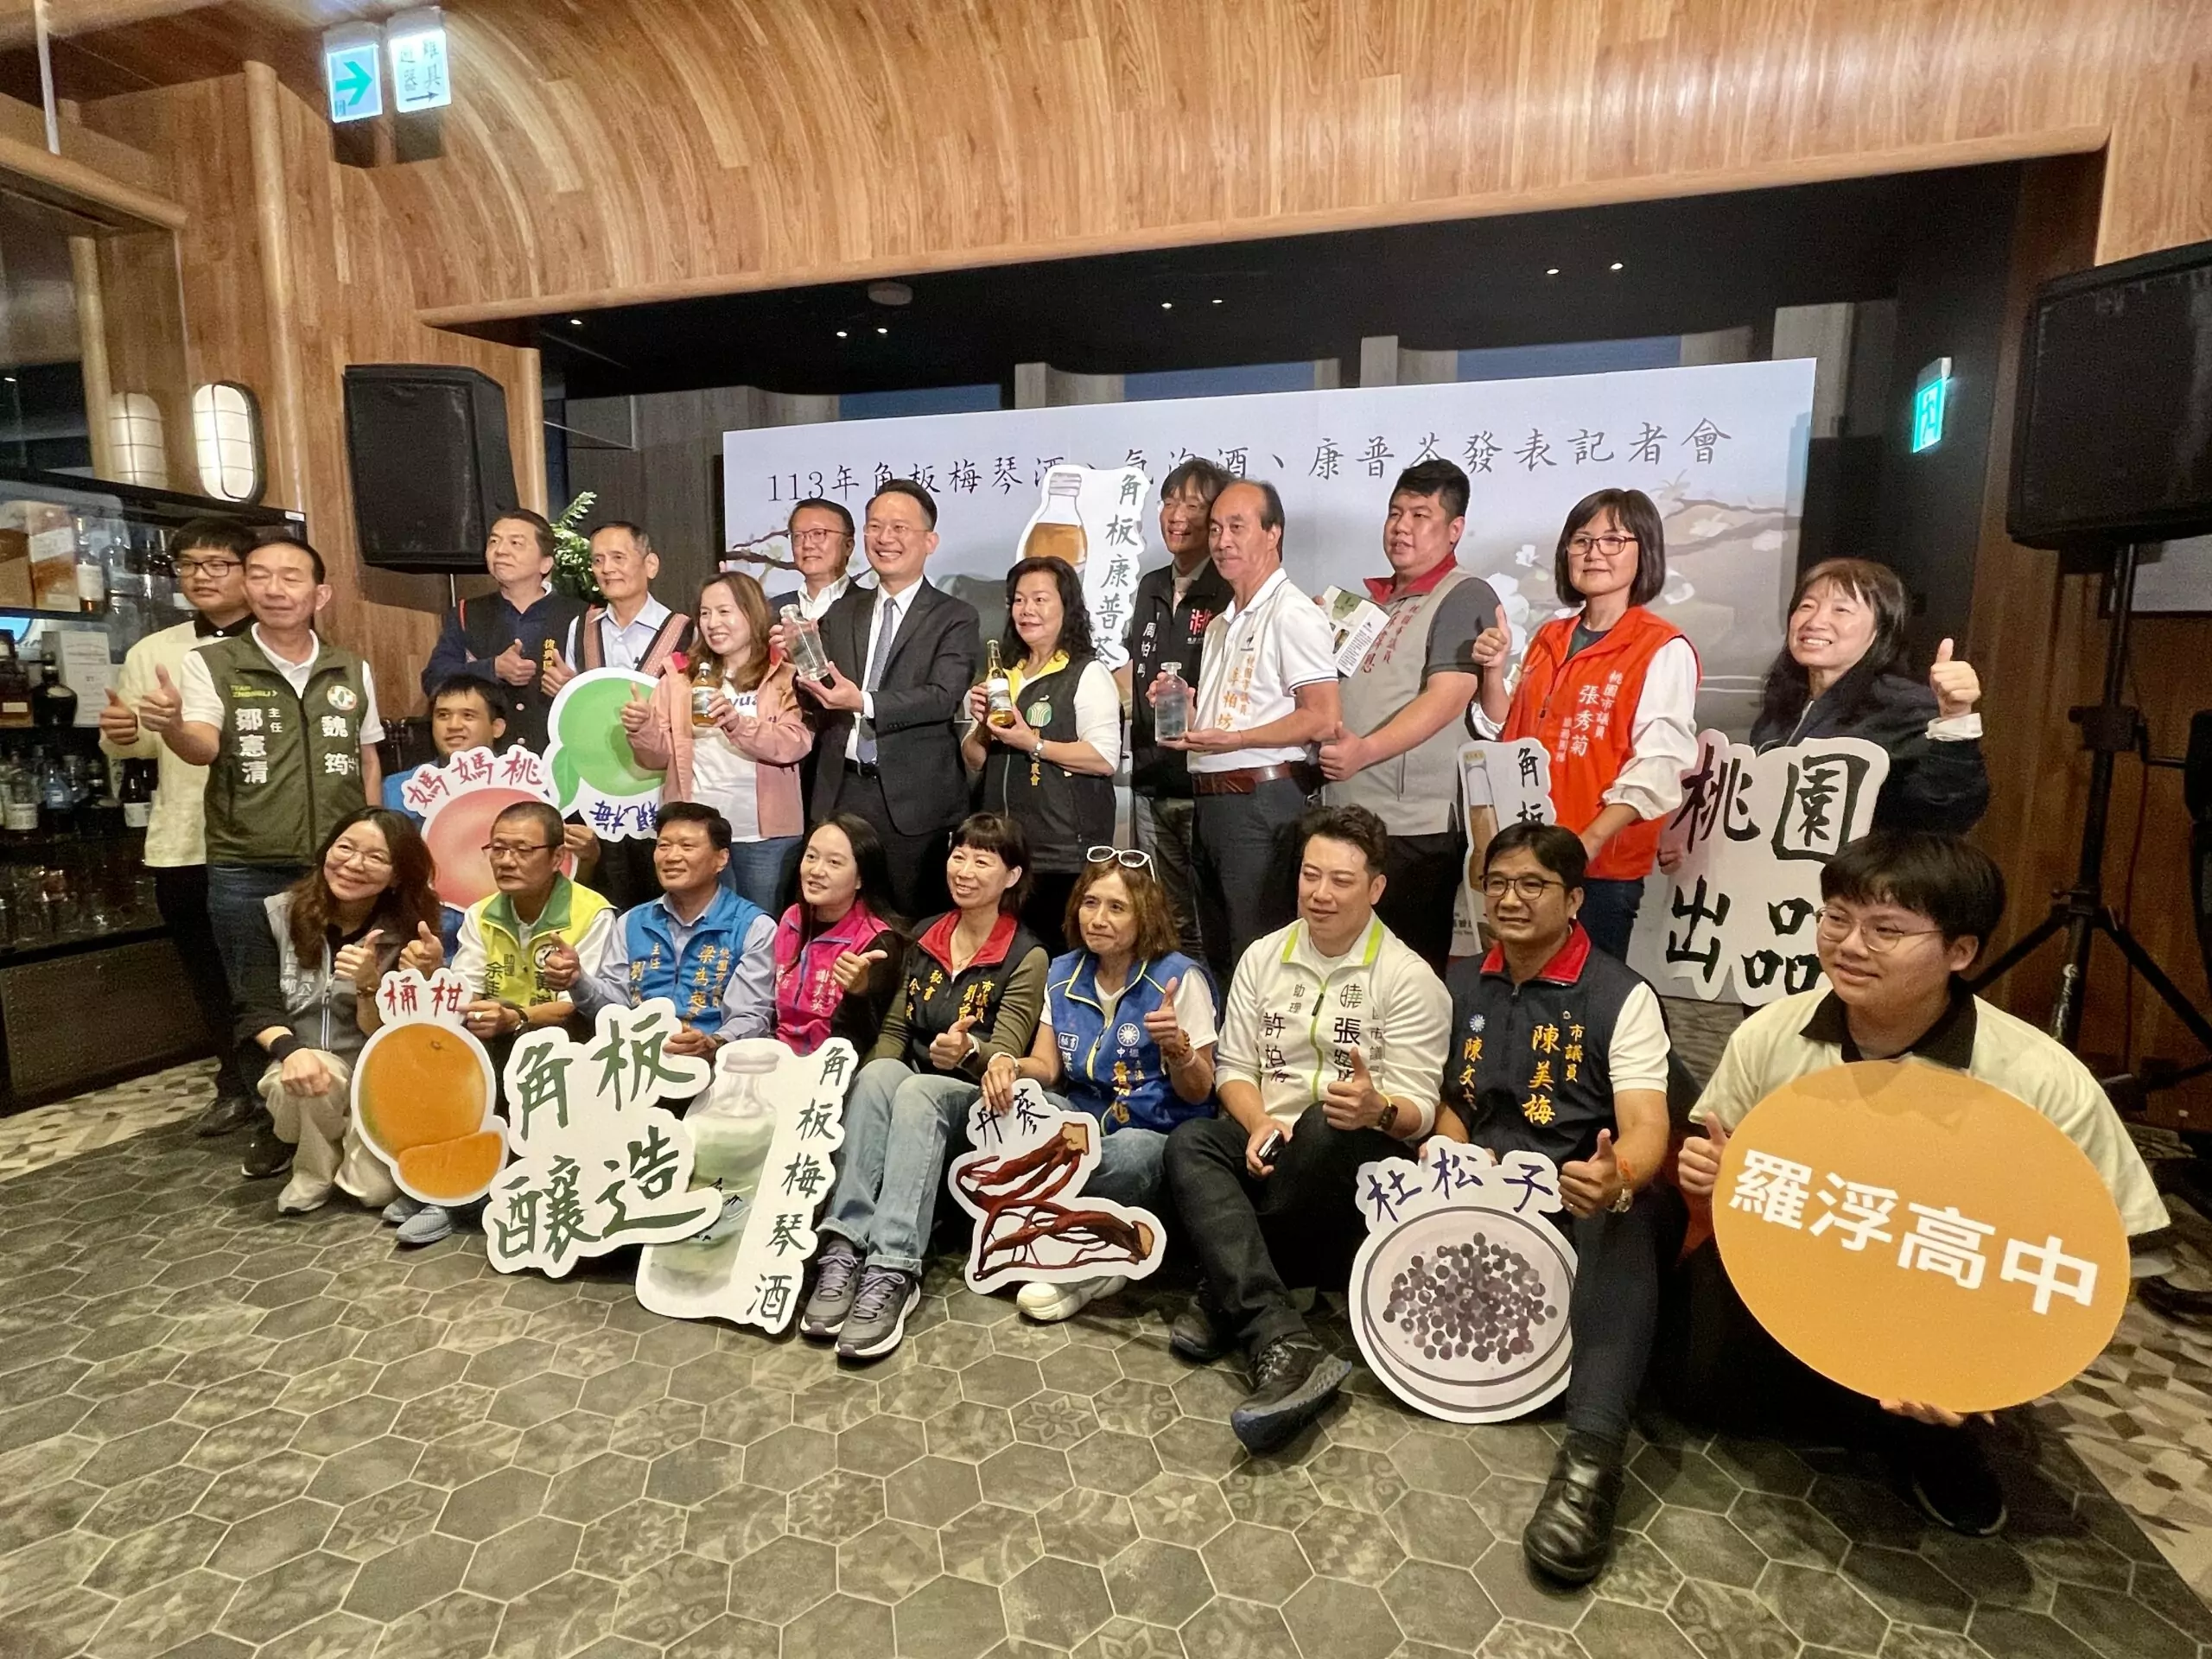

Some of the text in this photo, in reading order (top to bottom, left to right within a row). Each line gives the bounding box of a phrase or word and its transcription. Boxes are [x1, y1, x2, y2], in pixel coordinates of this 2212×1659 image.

[268, 707, 283, 734] 主任
[1571, 685, 1600, 757] 張秀菊
[1594, 671, 1624, 741] 桃園市議員
[406, 751, 543, 810] 媽媽桃
[1669, 742, 1871, 864] 桃園
[1666, 874, 1825, 996] 出品
[383, 976, 464, 1019] 桶柑
[1287, 983, 1306, 1014] 助理
[516, 1012, 696, 1141] 角板
[1522, 1023, 1560, 1125] 陳美梅
[1565, 1024, 1586, 1083] 市議員
[493, 1125, 707, 1263] 釀造
[746, 1046, 849, 1324] 角板梅琴酒
[1365, 1147, 1554, 1223] 杜松子
[1727, 1148, 2099, 1316] 羅浮高中
